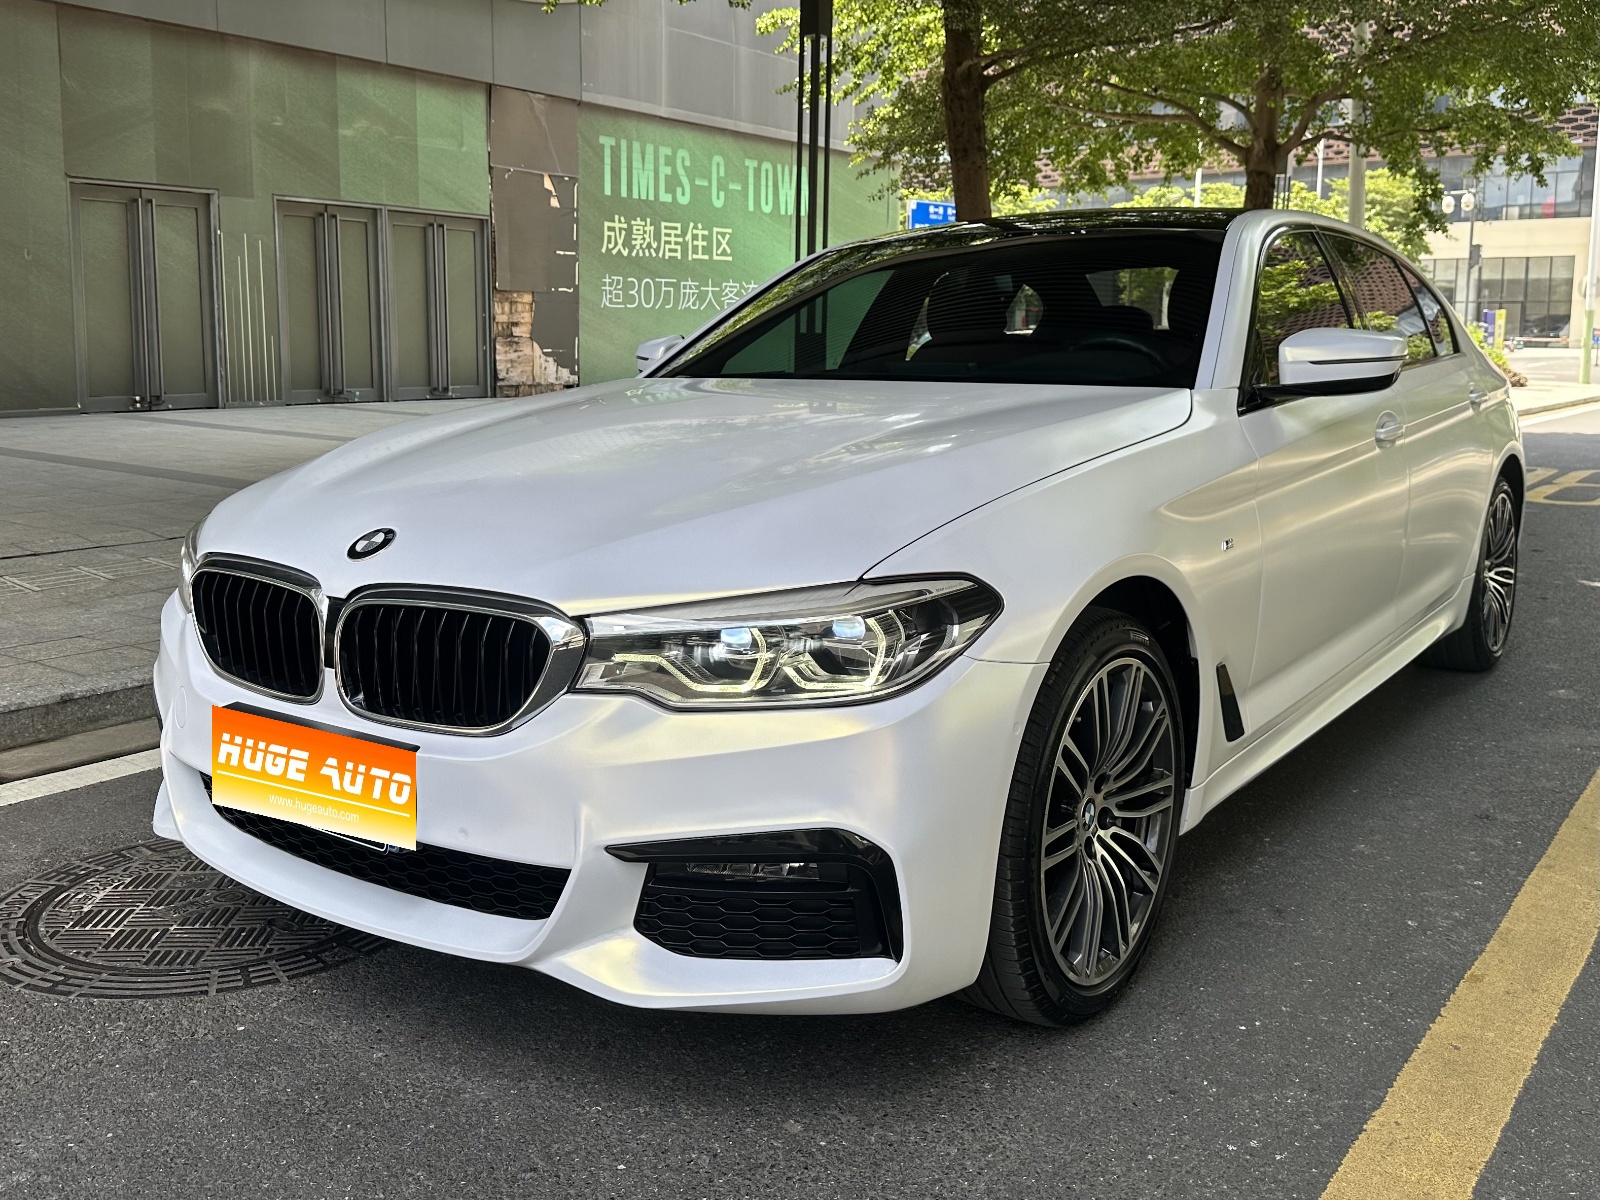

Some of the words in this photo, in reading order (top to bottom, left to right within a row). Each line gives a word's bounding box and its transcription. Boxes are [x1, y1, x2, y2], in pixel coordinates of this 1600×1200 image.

[601, 214, 733, 261] 成熟居住区
